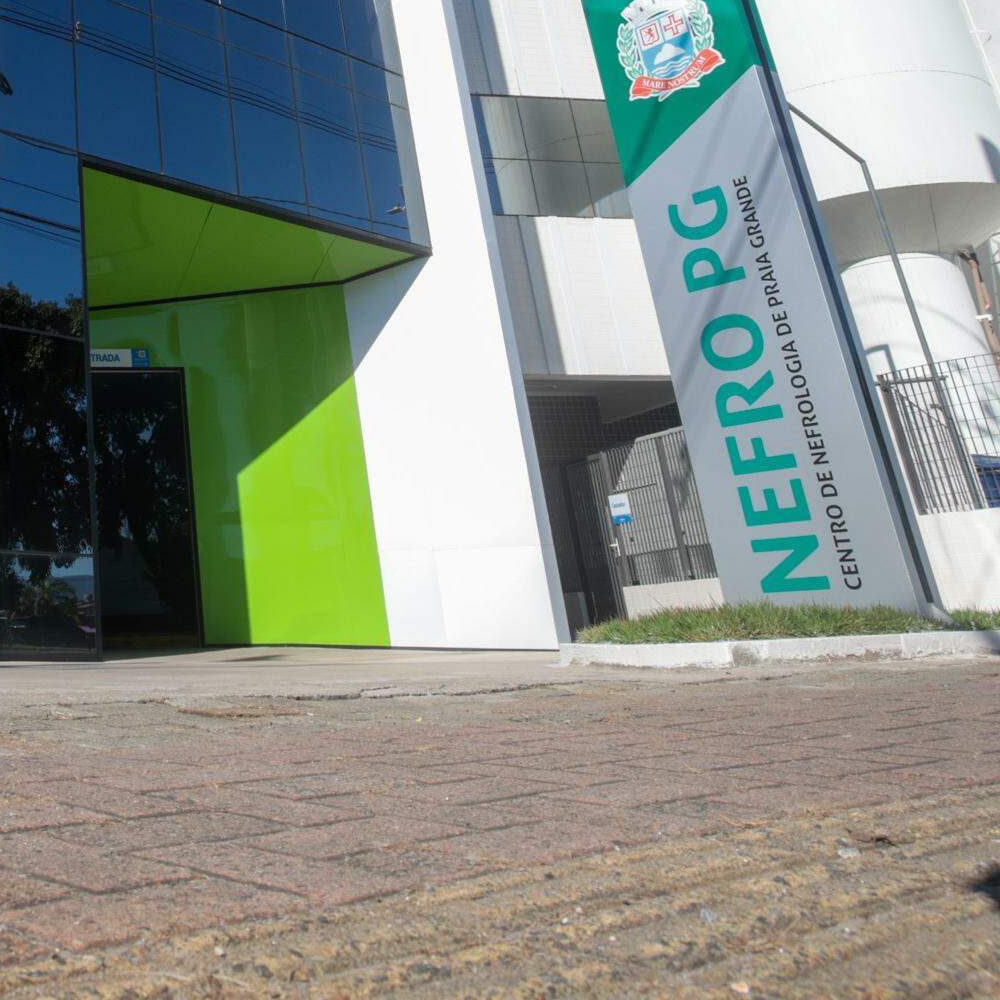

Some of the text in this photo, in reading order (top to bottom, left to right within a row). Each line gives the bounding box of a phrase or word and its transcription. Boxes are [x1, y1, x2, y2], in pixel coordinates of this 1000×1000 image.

[667, 184, 832, 594] NEFRO PG
[732, 175, 862, 591] CENTRO DE NEFROLOGIA DE PRAIA GRANDE
